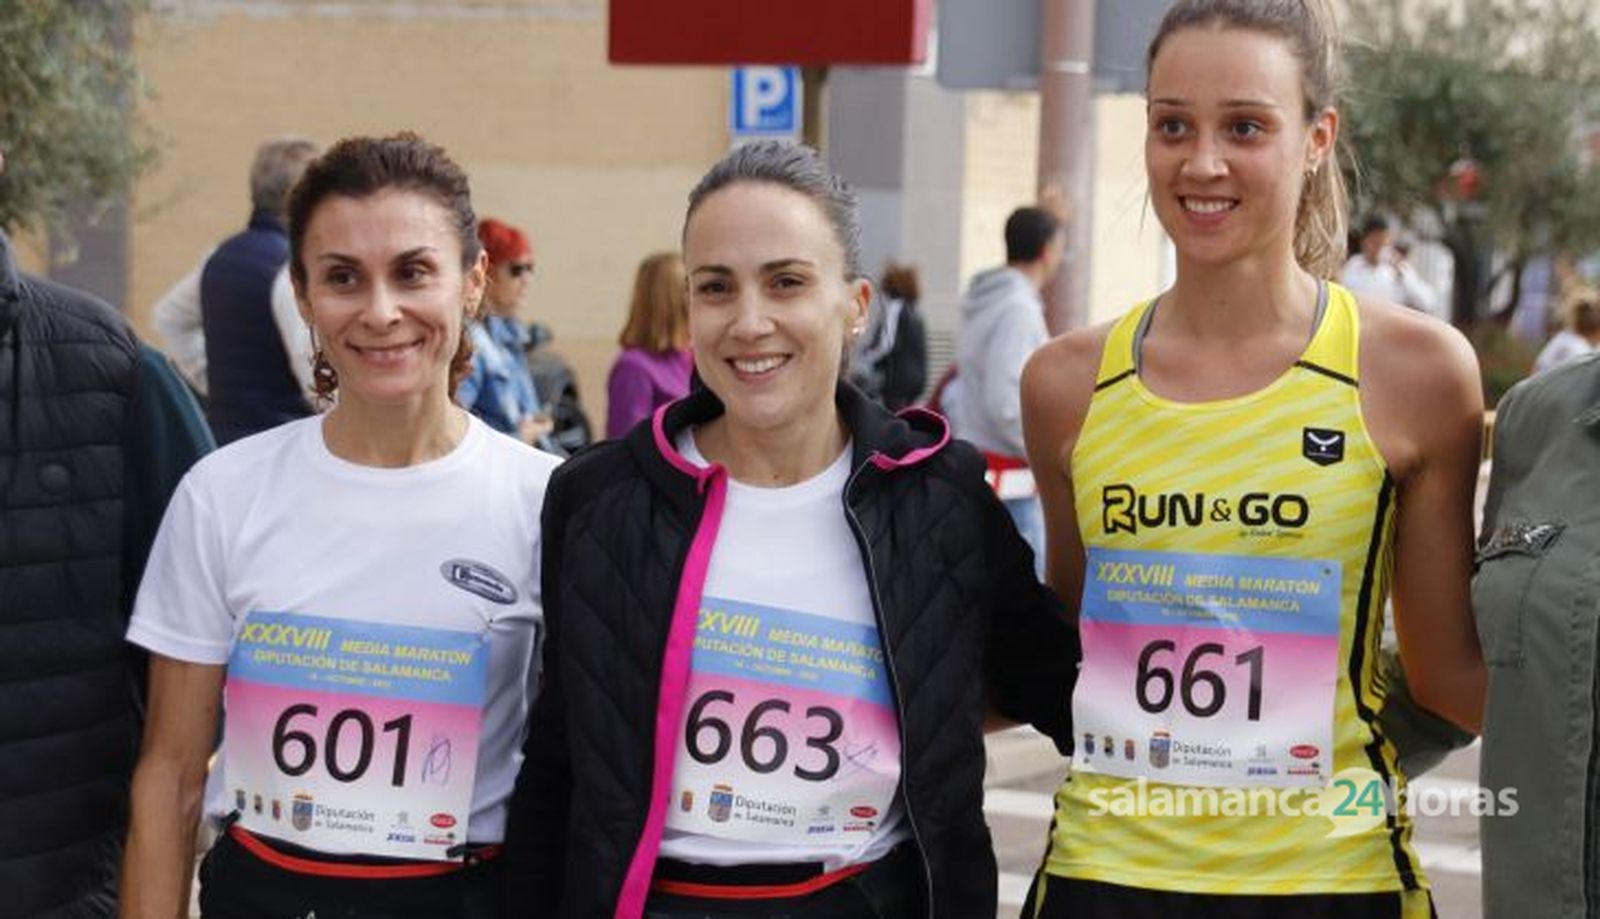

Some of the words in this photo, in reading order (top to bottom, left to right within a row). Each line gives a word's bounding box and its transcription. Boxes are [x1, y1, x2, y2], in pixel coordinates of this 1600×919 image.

[743, 66, 787, 128] P
[1103, 484, 1204, 535] RUN
[1210, 498, 1231, 522] &
[1238, 493, 1309, 528] GO
[1096, 562, 1175, 587] XXXVIII
[1186, 573, 1234, 589] MEDIA
[239, 623, 332, 651] XXXVIII
[341, 641, 389, 657] MEDIA
[768, 628, 819, 649] MEDIA
[1135, 639, 1264, 722] 661
[272, 703, 413, 788] 601
[685, 690, 843, 782] 663
